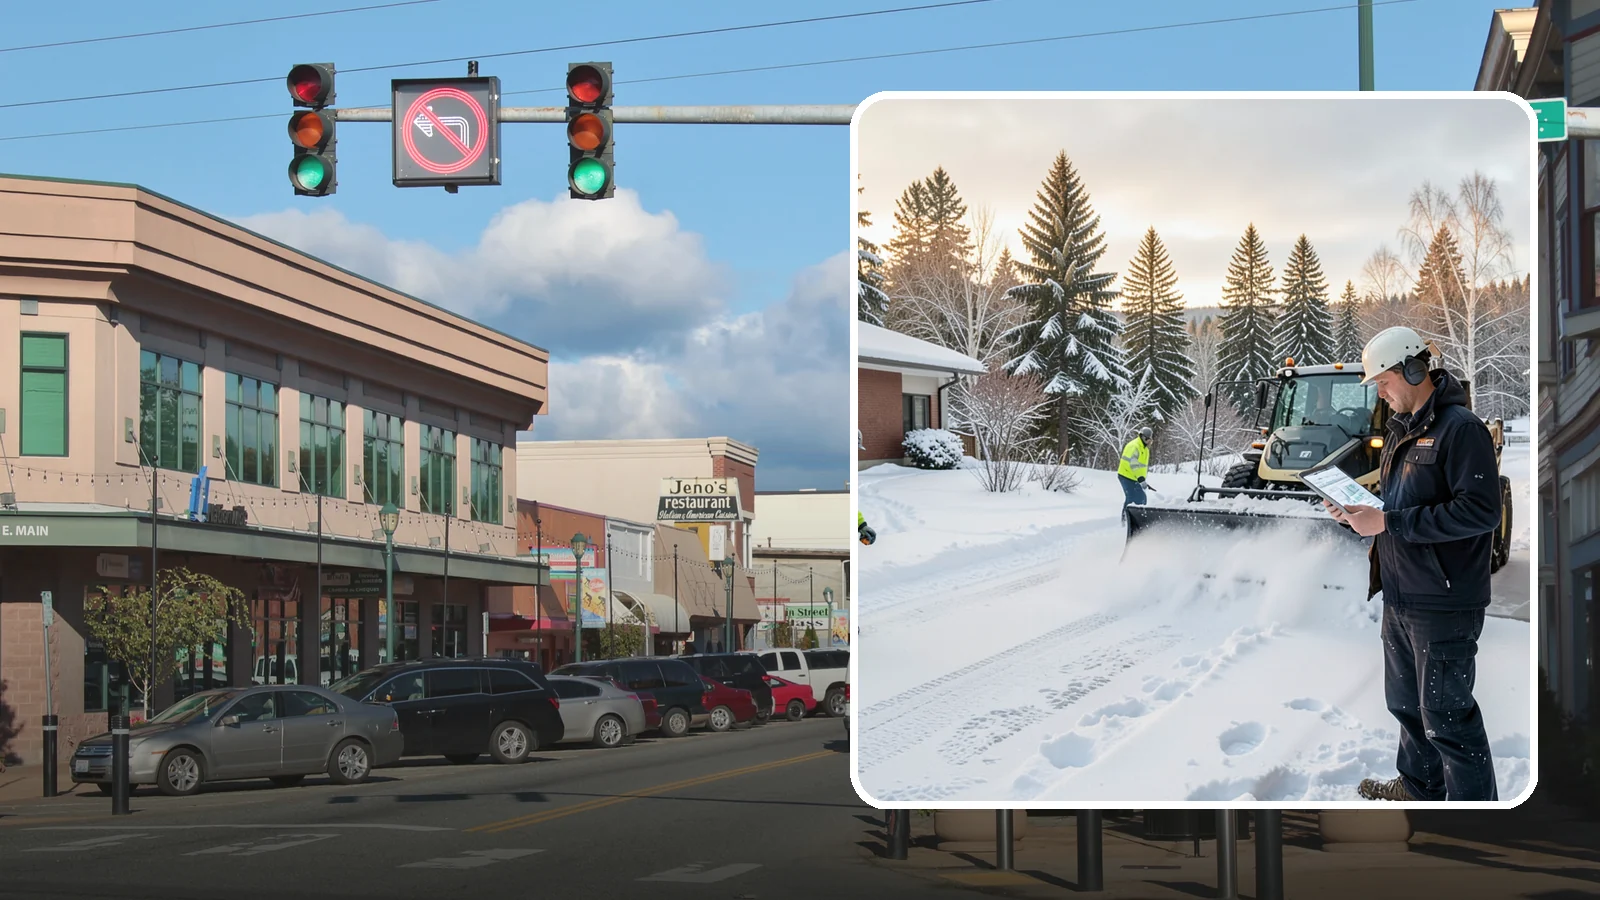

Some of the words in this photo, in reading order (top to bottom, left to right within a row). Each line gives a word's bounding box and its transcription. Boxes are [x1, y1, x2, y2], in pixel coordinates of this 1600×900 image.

[670, 480, 727, 494] Jeno's
[666, 496, 731, 508] restaurant
[659, 510, 681, 519] Italian
[686, 509, 715, 519] American
[715, 509, 737, 519] Cuisine
[2, 525, 13, 536] E.
[15, 525, 49, 536] MAIN
[797, 607, 828, 616] Street
[791, 619, 824, 627] lass
